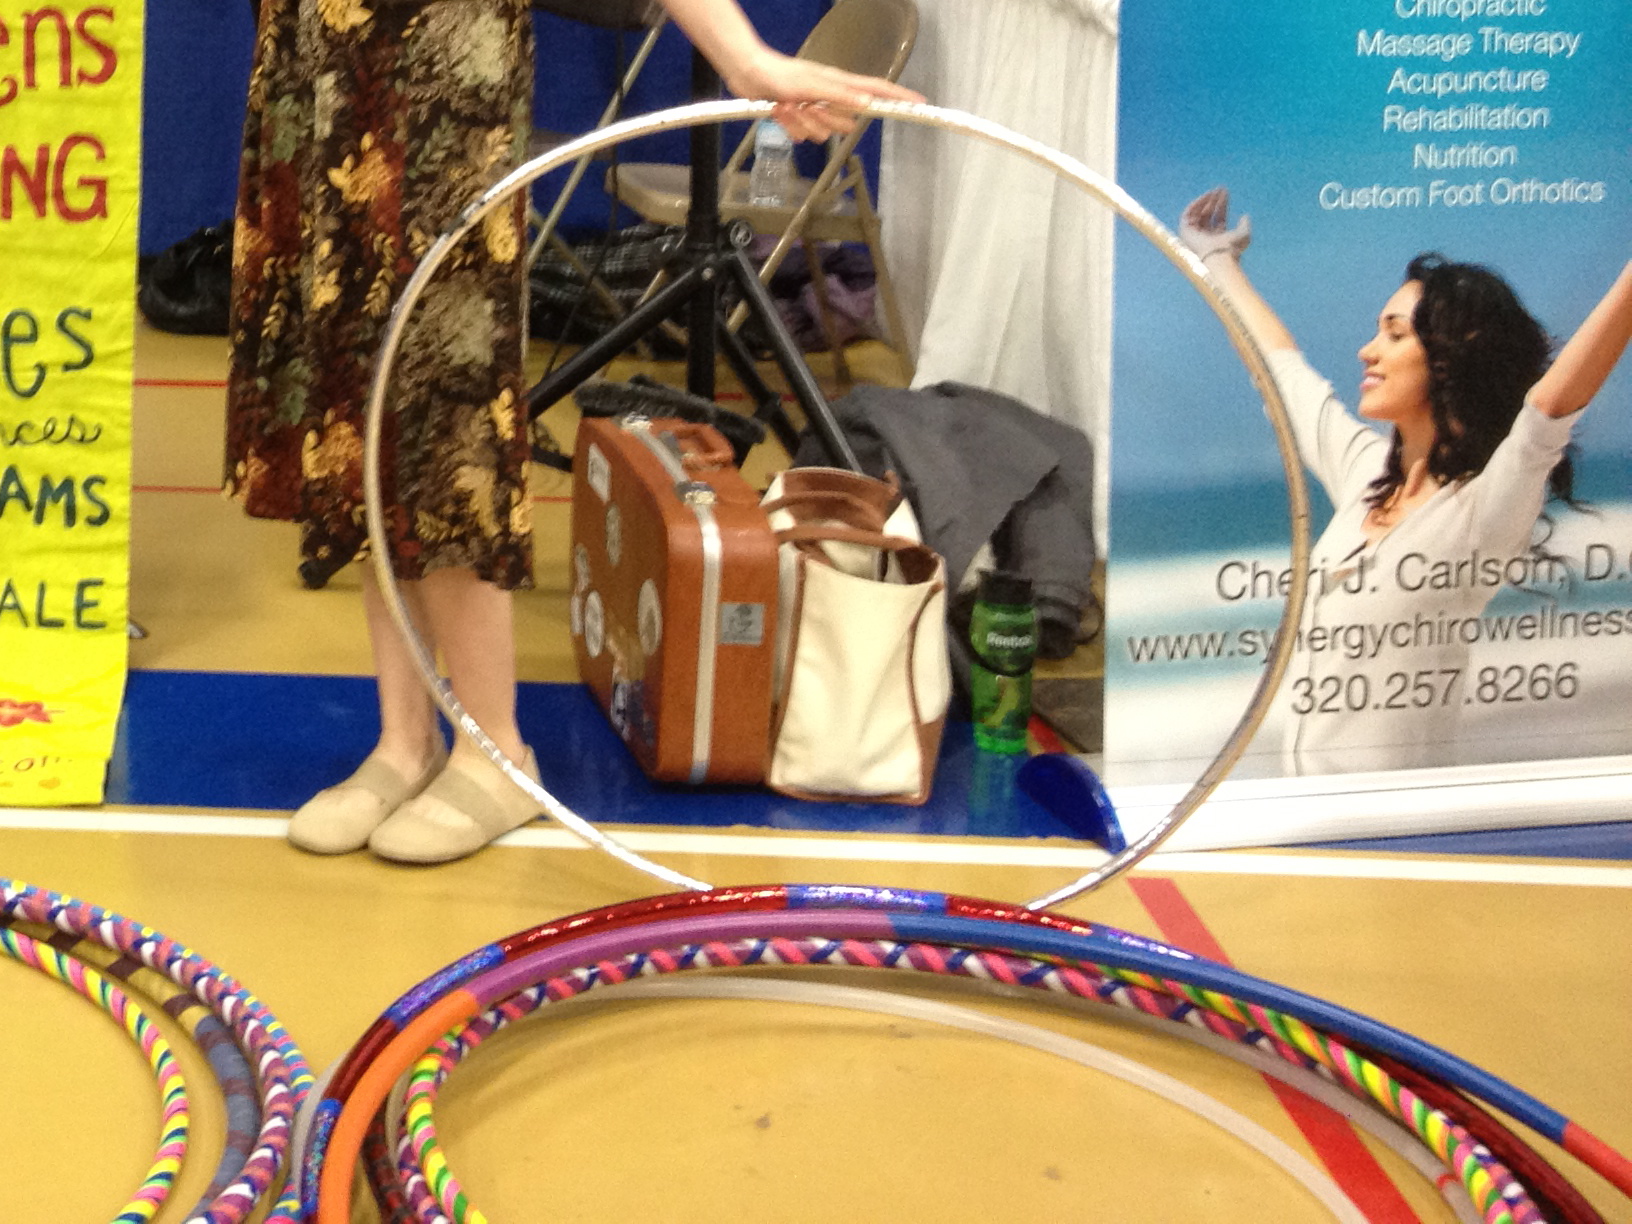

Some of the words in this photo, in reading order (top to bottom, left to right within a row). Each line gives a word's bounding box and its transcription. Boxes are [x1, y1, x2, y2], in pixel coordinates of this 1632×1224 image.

[1355, 28, 1475, 62] Massage
[1478, 25, 1585, 59] Therapy
[1386, 65, 1552, 100] Acupuncture
[1382, 101, 1552, 134] Rehabilitation
[1412, 140, 1519, 170] Nutrition
[1317, 181, 1422, 211] Custom
[1428, 178, 1485, 208] Foot
[1489, 175, 1608, 206] Orthotics
[1342, 556, 1379, 595] J.
[1583, 542, 1632, 582] D.
[1290, 662, 1581, 716] 320.257.8266
